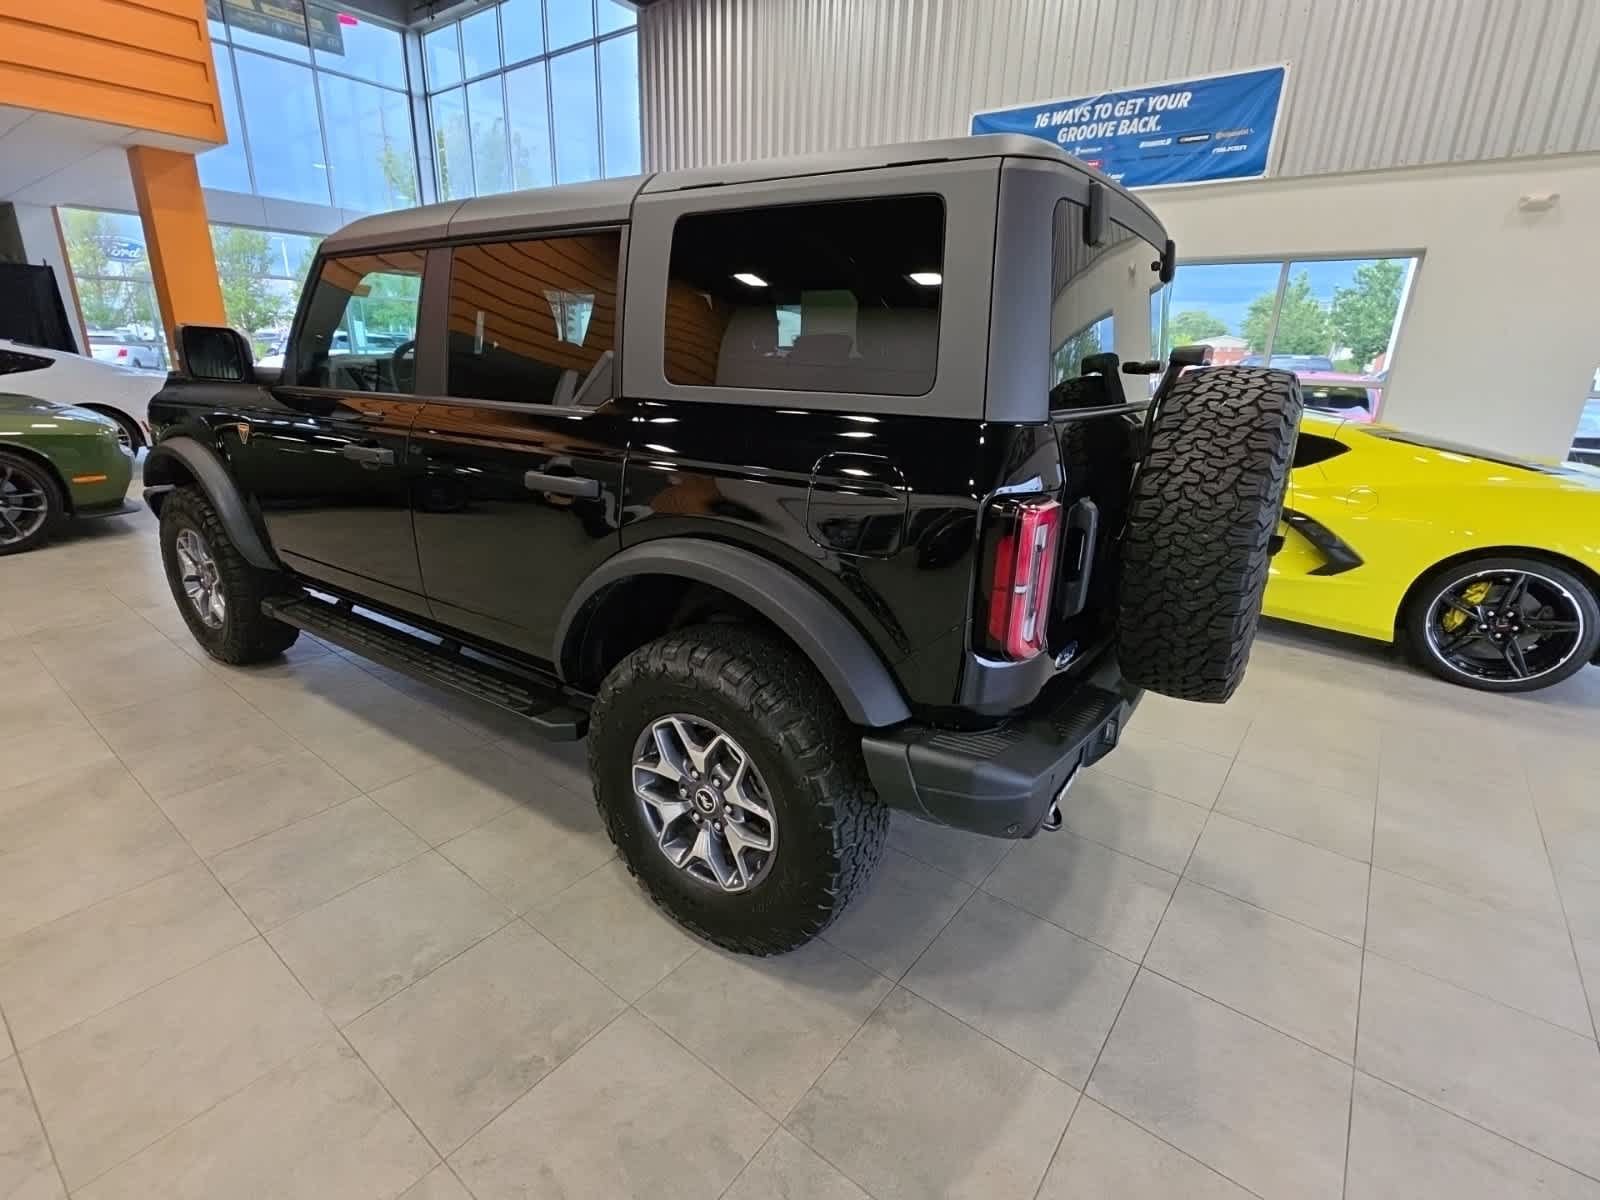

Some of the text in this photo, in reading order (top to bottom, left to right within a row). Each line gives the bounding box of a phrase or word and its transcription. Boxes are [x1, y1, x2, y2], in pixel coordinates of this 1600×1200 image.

[1034, 91, 1192, 128] 16 WAYS TO GET YOUR
[1056, 120, 1117, 144] GROOVE
[1117, 114, 1162, 136] BACK.
